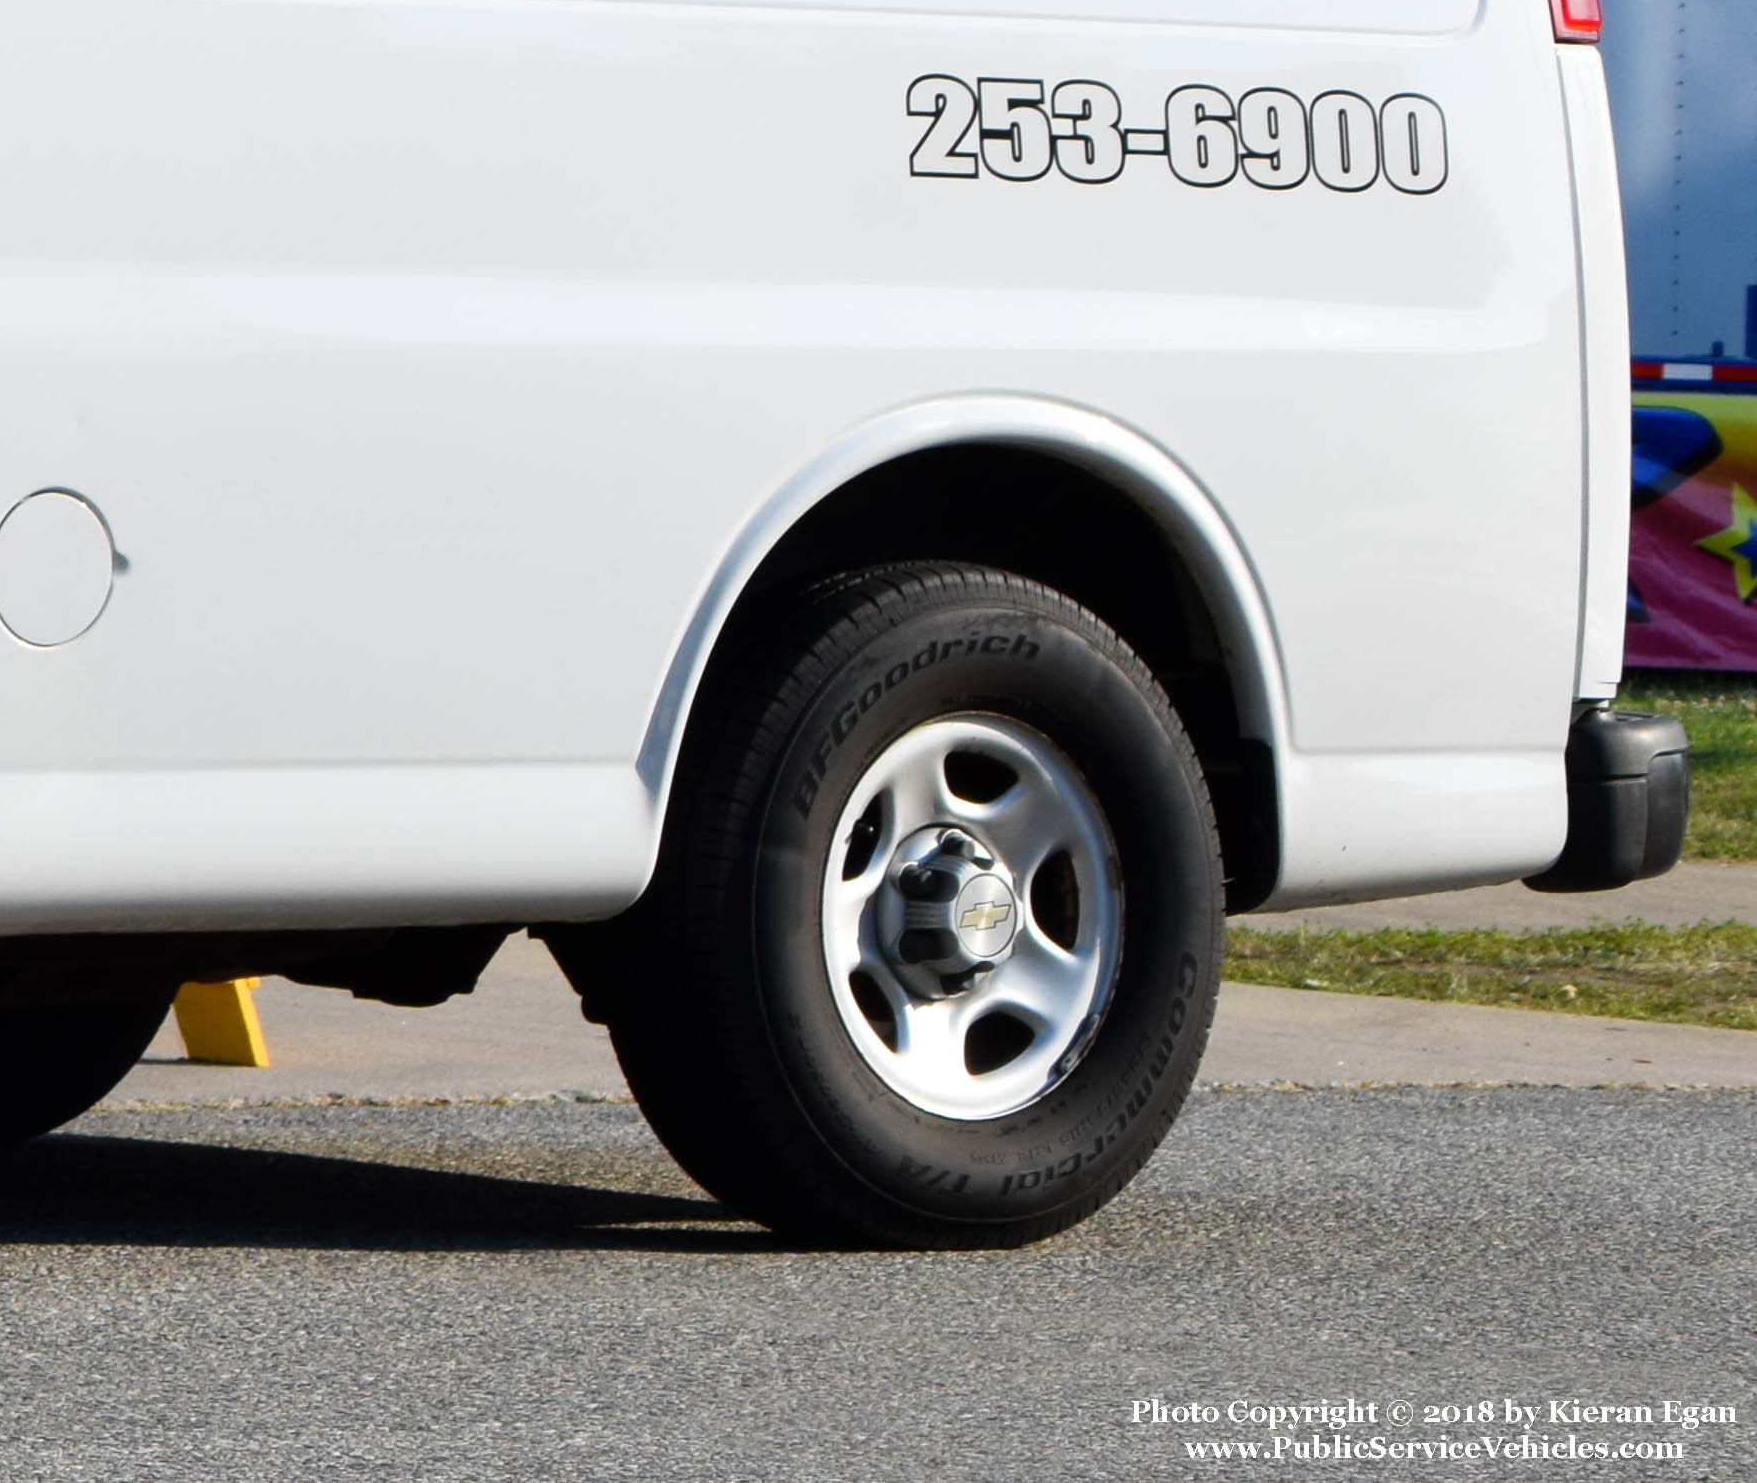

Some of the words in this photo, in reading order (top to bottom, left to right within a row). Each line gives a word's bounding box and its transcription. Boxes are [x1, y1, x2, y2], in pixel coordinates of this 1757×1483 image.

[906, 73, 1449, 196] 253-6900
[794, 631, 1041, 821] BFGoodrich
[999, 951, 1198, 1197] Commercial
